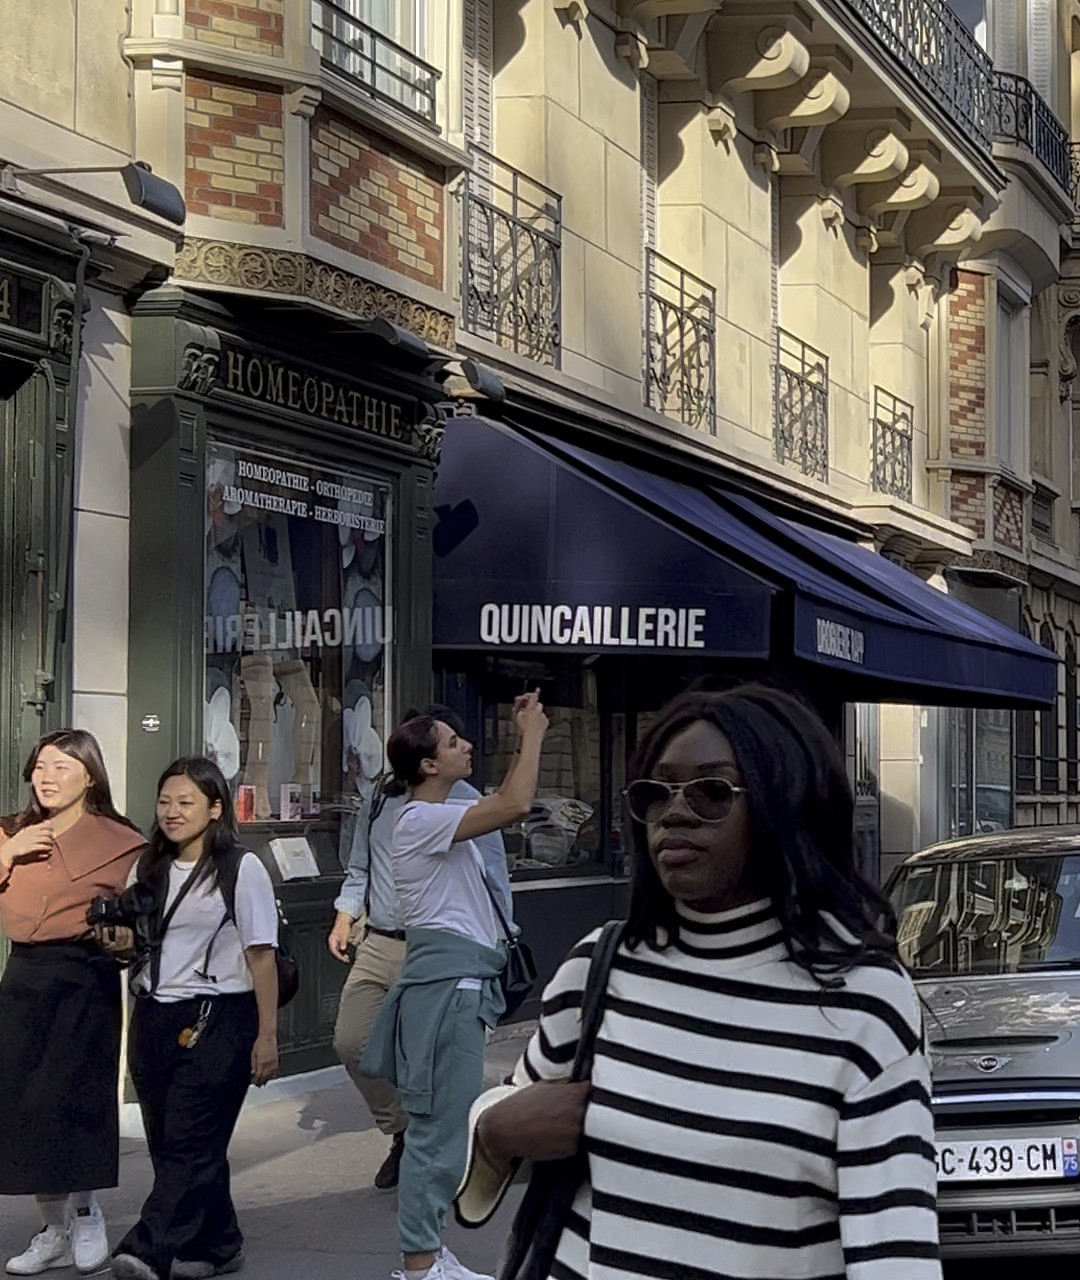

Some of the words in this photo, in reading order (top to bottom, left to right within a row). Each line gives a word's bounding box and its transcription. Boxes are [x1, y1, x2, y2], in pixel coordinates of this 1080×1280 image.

[226, 350, 402, 438] HOMEOPATHIE
[238, 460, 309, 491] HOMEOPATHIE
[316, 481, 374, 506] ORTHOPEDIE
[222, 485, 308, 517] AROMATHERAPIE
[314, 505, 385, 534] HERBORISTERIE
[480, 603, 706, 648] QUINCAILLERIE
[934, 1143, 1057, 1176] C-439-CM
[1063, 1156, 1078, 1170] 75
